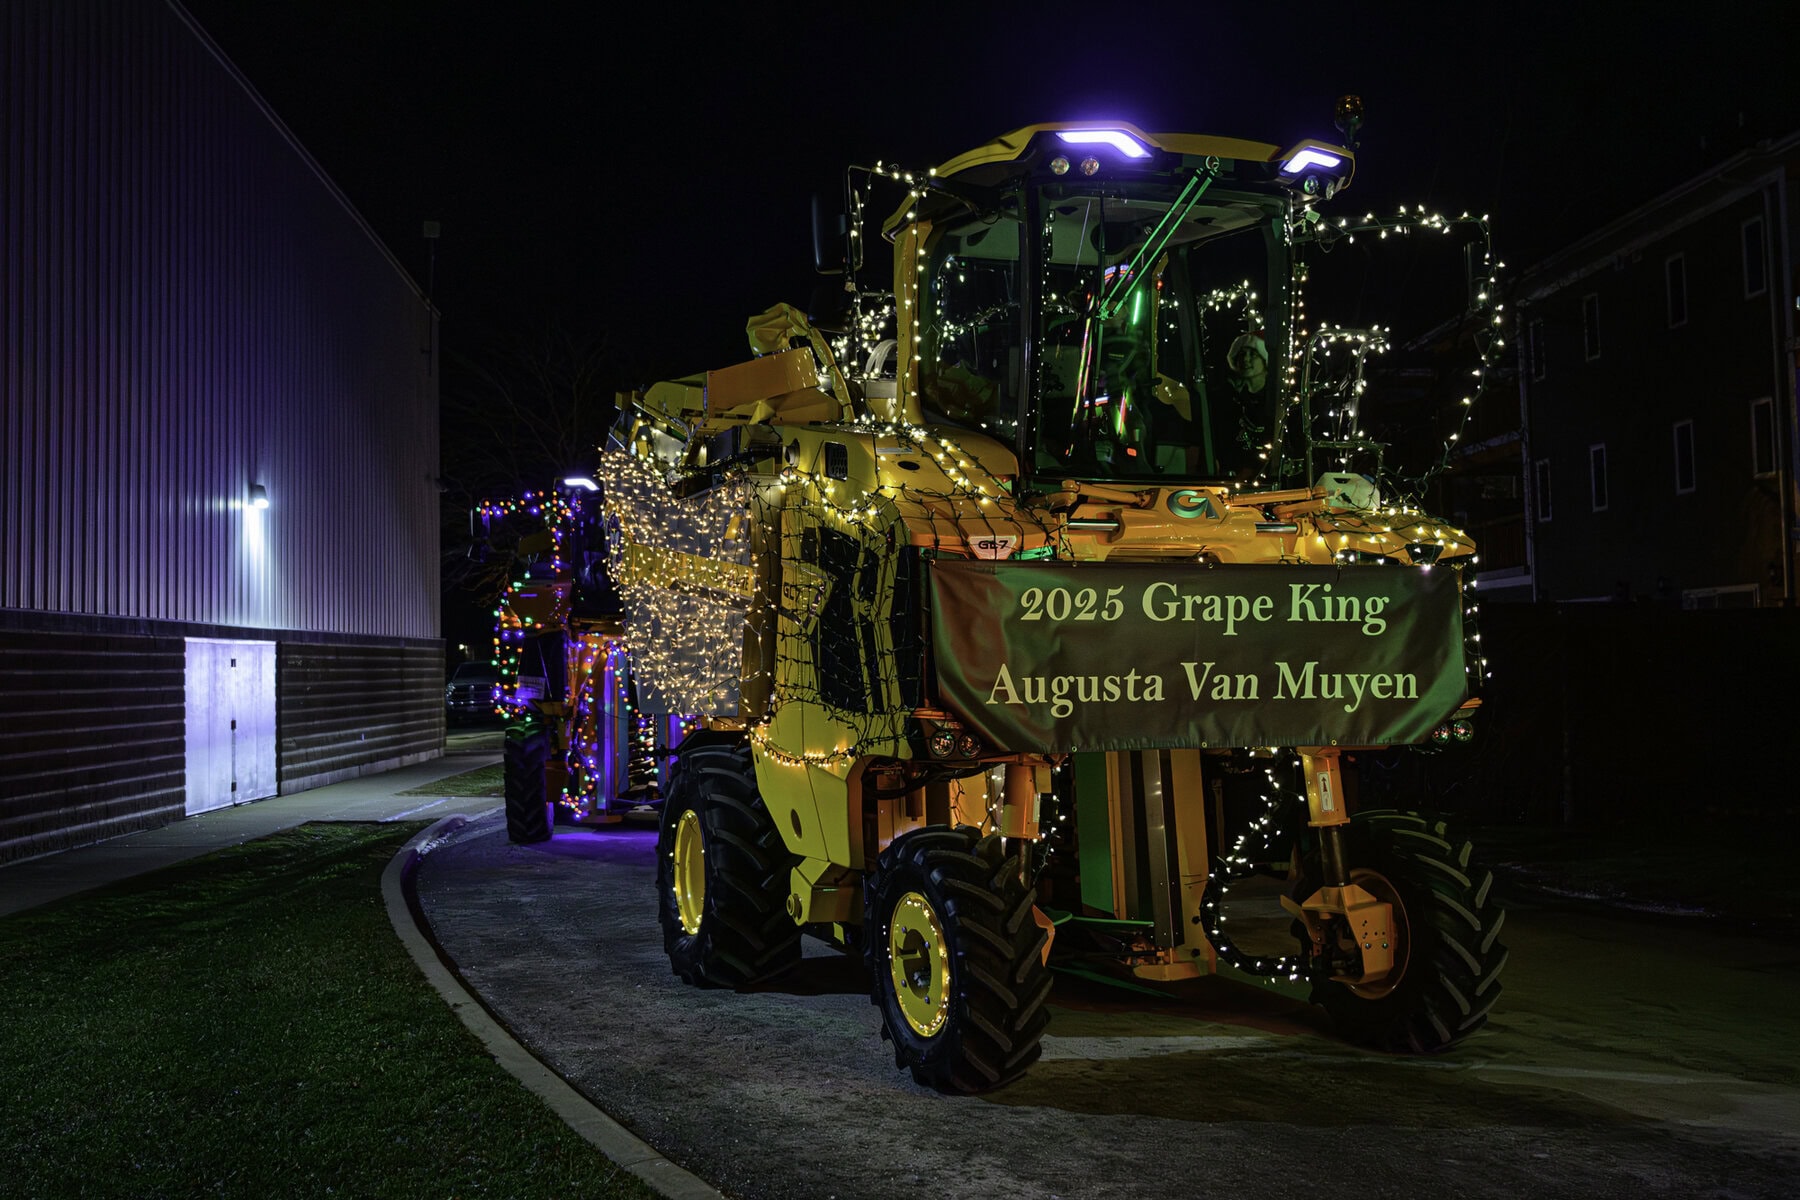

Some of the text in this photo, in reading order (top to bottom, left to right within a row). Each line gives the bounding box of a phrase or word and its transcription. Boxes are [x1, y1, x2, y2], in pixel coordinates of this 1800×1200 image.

[1019, 582, 1391, 637] 2025 Grape King
[985, 661, 1420, 719] Augusta Van Muyen
